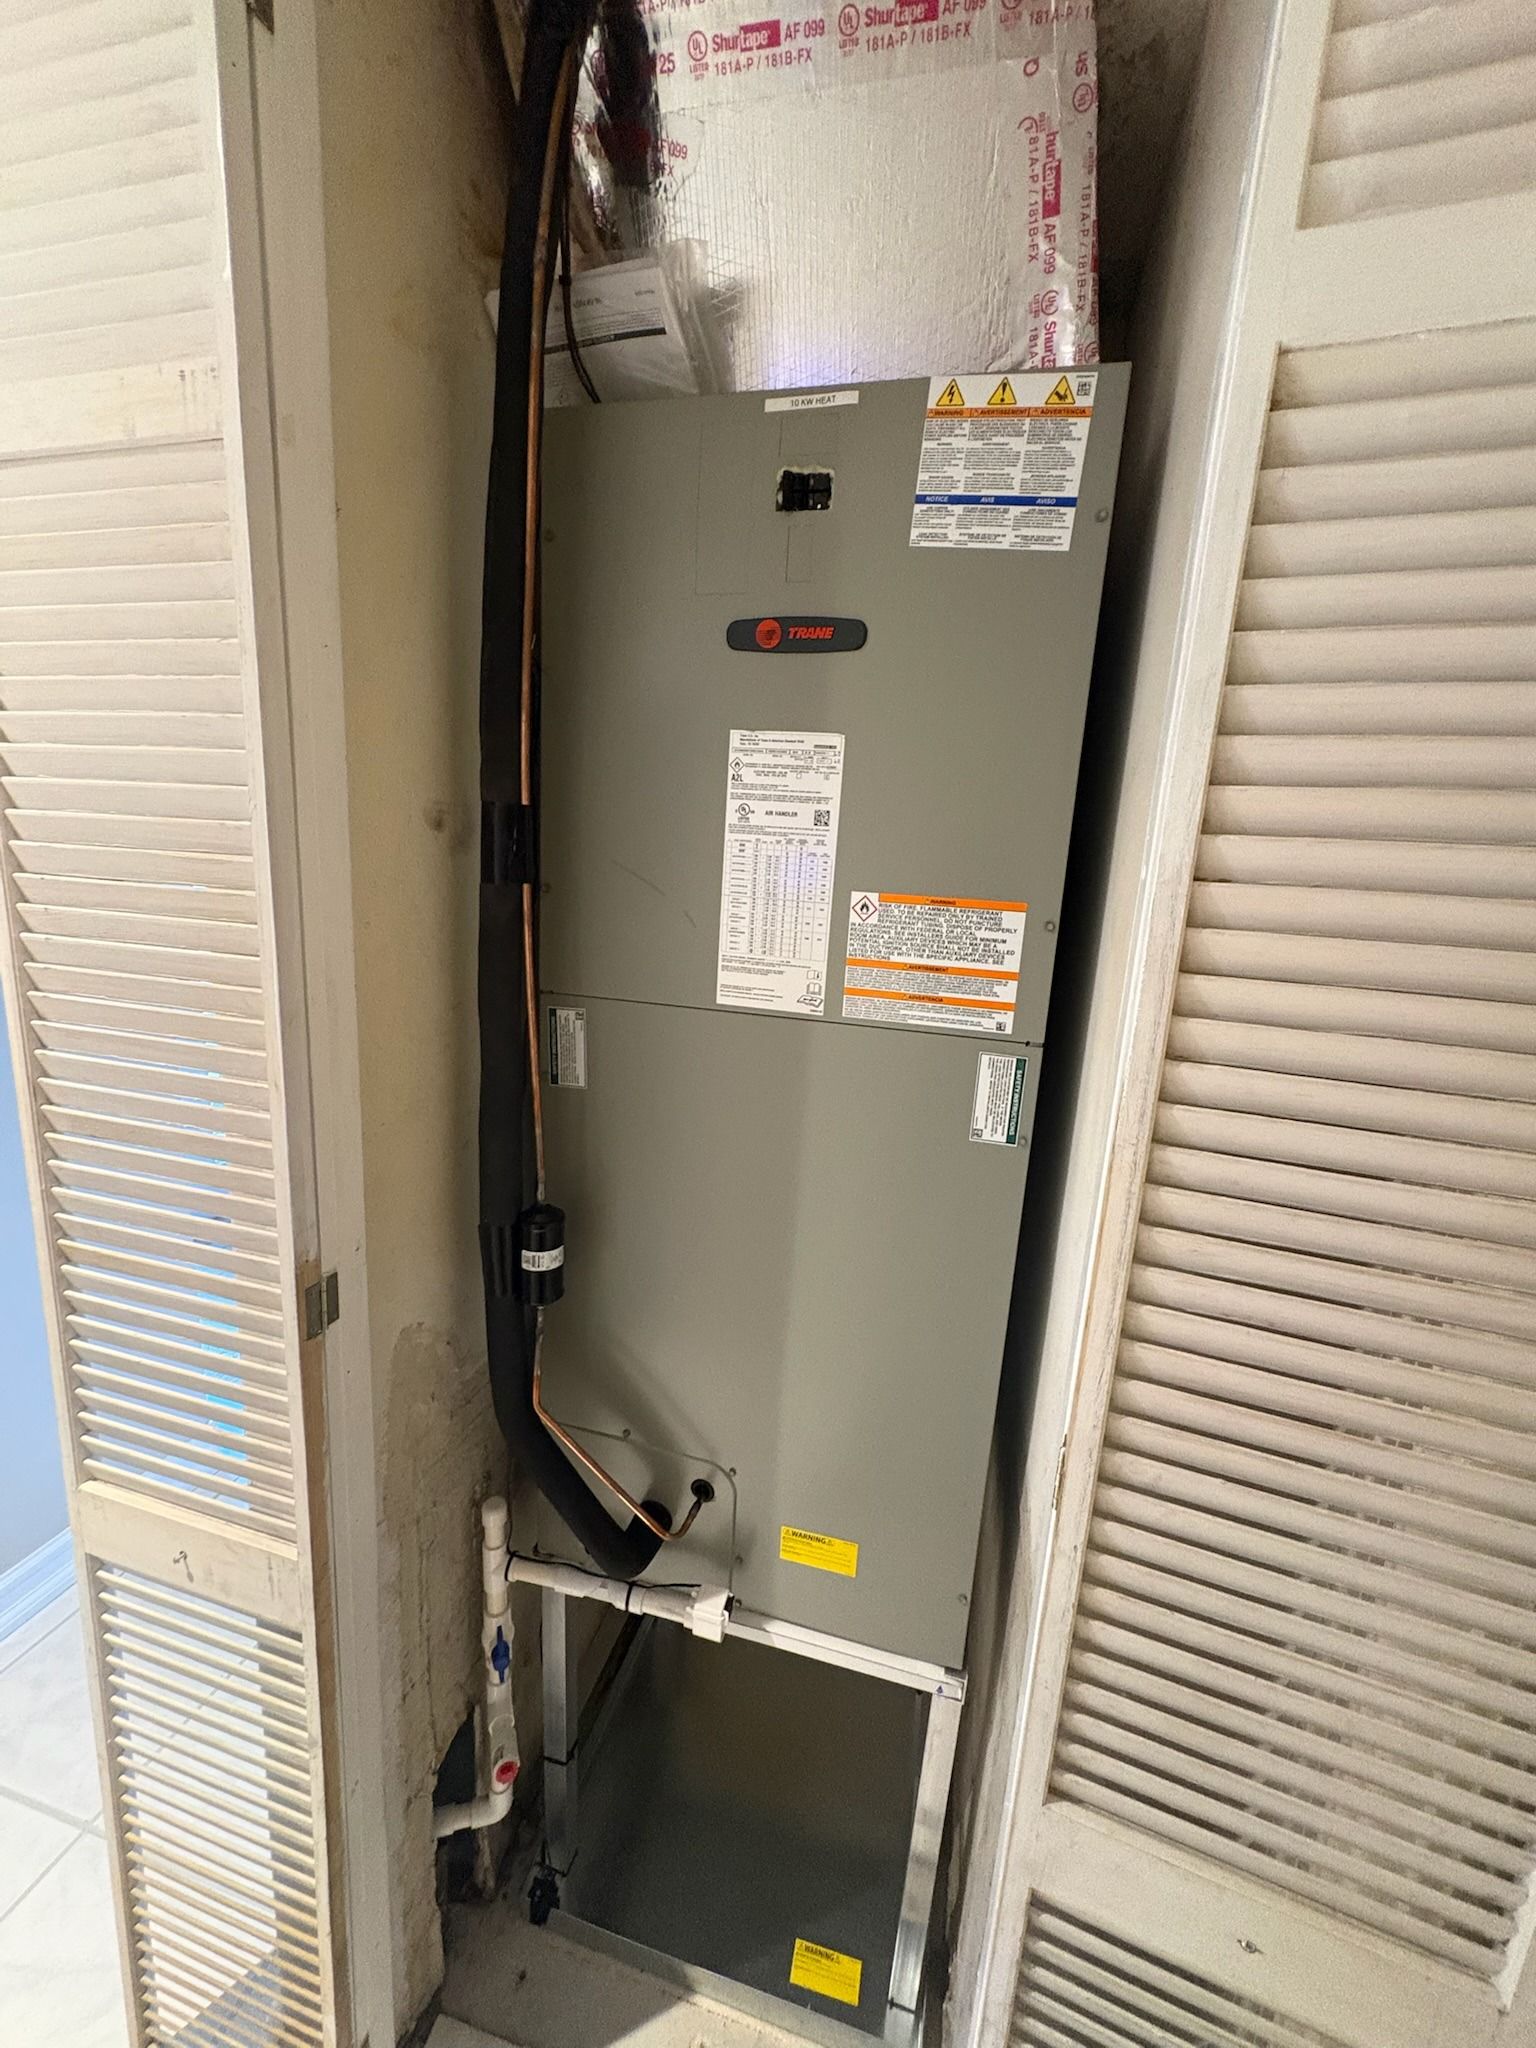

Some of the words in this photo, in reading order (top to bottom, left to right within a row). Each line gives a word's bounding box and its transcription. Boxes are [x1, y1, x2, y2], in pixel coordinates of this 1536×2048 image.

[865, 3, 932, 26] Shurtape
[712, 28, 774, 54] Shurtape
[784, 22, 802, 42] AF
[803, 18, 826, 38] 099
[865, 33, 908, 54] 181A-P
[920, 21, 972, 44] 181B-FX
[714, 56, 754, 76] 181A-P
[765, 47, 814, 68] 181B-FX
[1028, 136, 1040, 184] 81A-P
[1043, 129, 1062, 206] hurtape
[1028, 201, 1040, 264] 181B-FX
[1044, 223, 1058, 244] AF
[1043, 247, 1058, 274] 099
[1075, 254, 1088, 314] 181B-FX
[791, 397, 800, 408] 10
[800, 396, 814, 406] KW
[815, 394, 838, 406] HEAT
[788, 626, 836, 640] TRANE
[731, 773, 743, 781] A2L
[1014, 1070, 1024, 1092] SAFETY
[1009, 1092, 1020, 1136] INSTRUCTIONS
[791, 1530, 826, 1544] WARNING
[804, 1943, 836, 1962] WARNING
